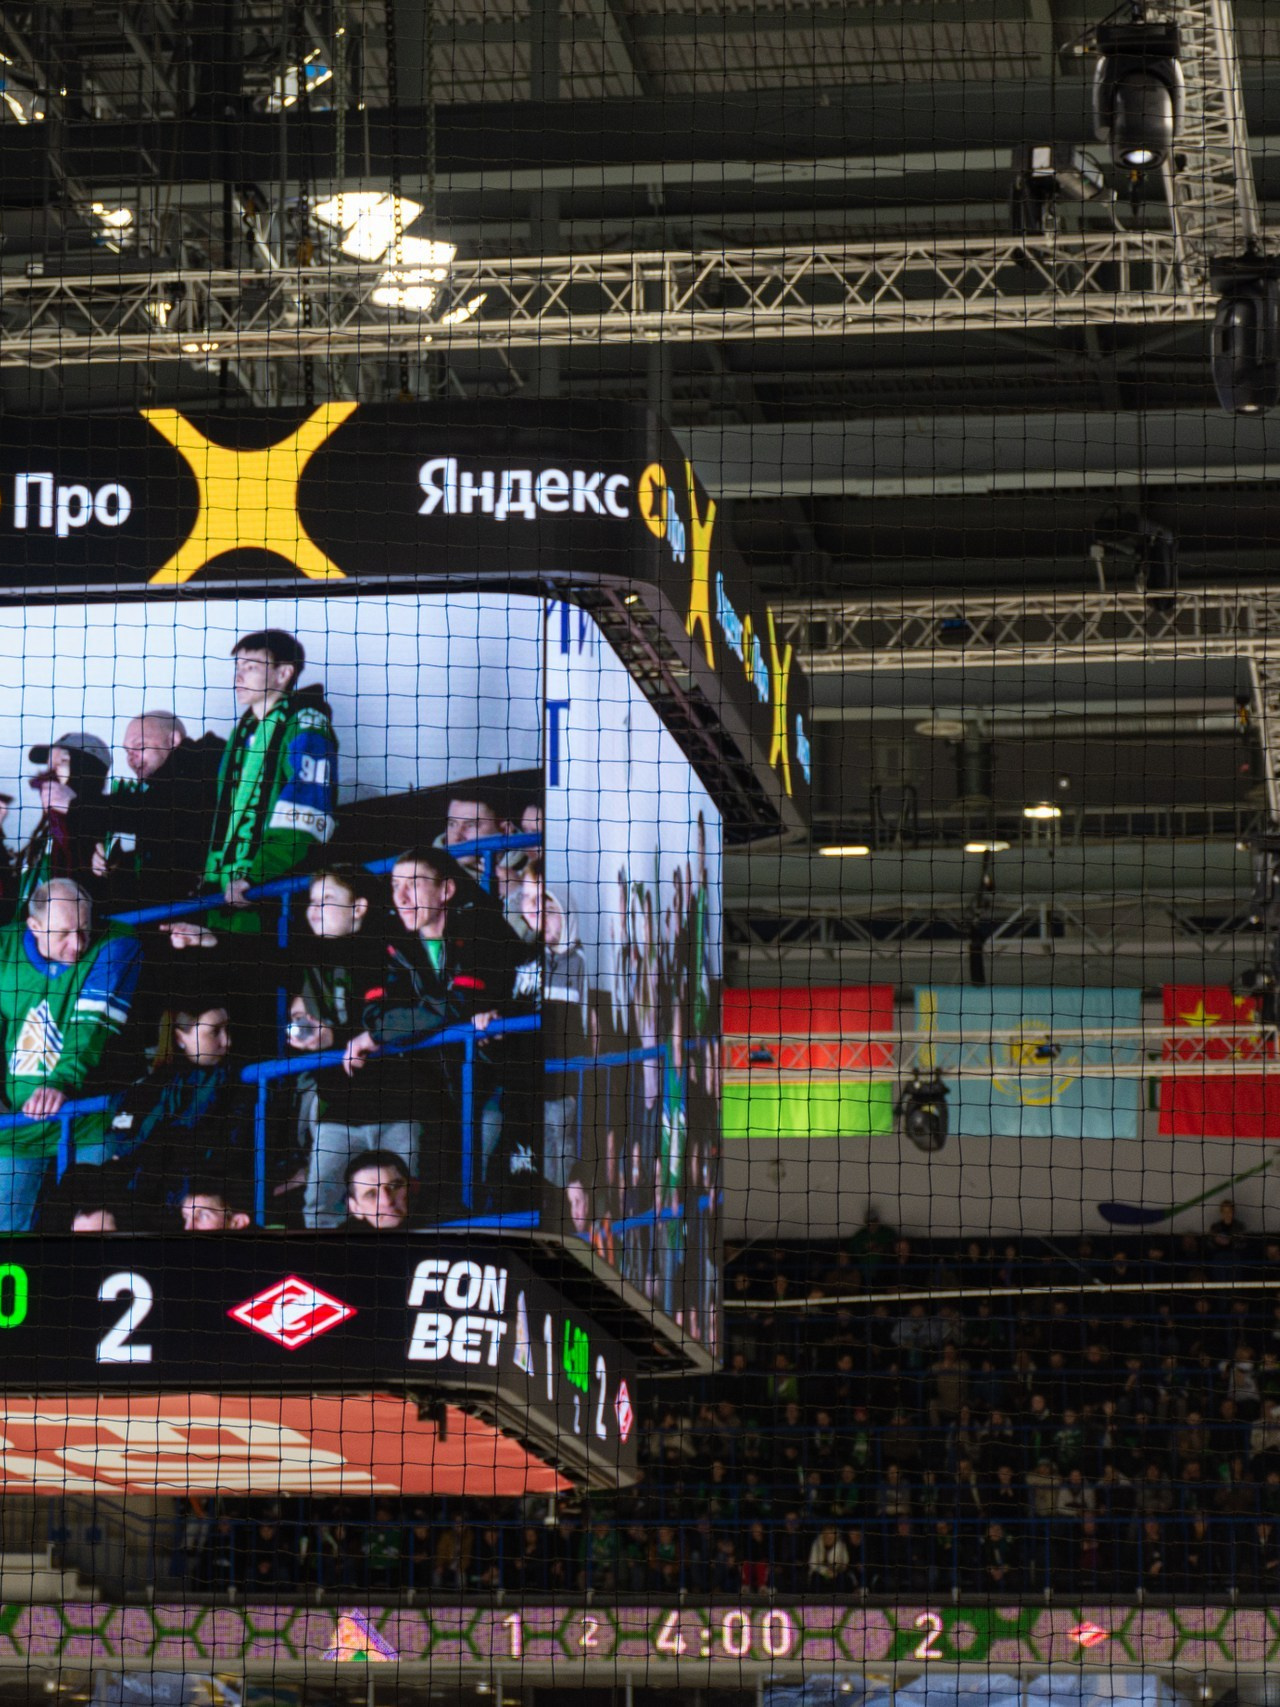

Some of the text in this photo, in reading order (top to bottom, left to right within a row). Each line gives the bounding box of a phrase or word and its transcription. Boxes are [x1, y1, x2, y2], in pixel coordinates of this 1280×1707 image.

[14, 472, 132, 538] Про
[417, 457, 630, 522] Яндекс
[407, 1259, 508, 1315] FON
[96, 1272, 153, 1364] 2
[407, 1312, 508, 1367] BET
[503, 1612, 521, 1659] 1
[579, 1616, 599, 1647] 2
[656, 1610, 793, 1656] 4:00
[914, 1613, 943, 1659] 2
